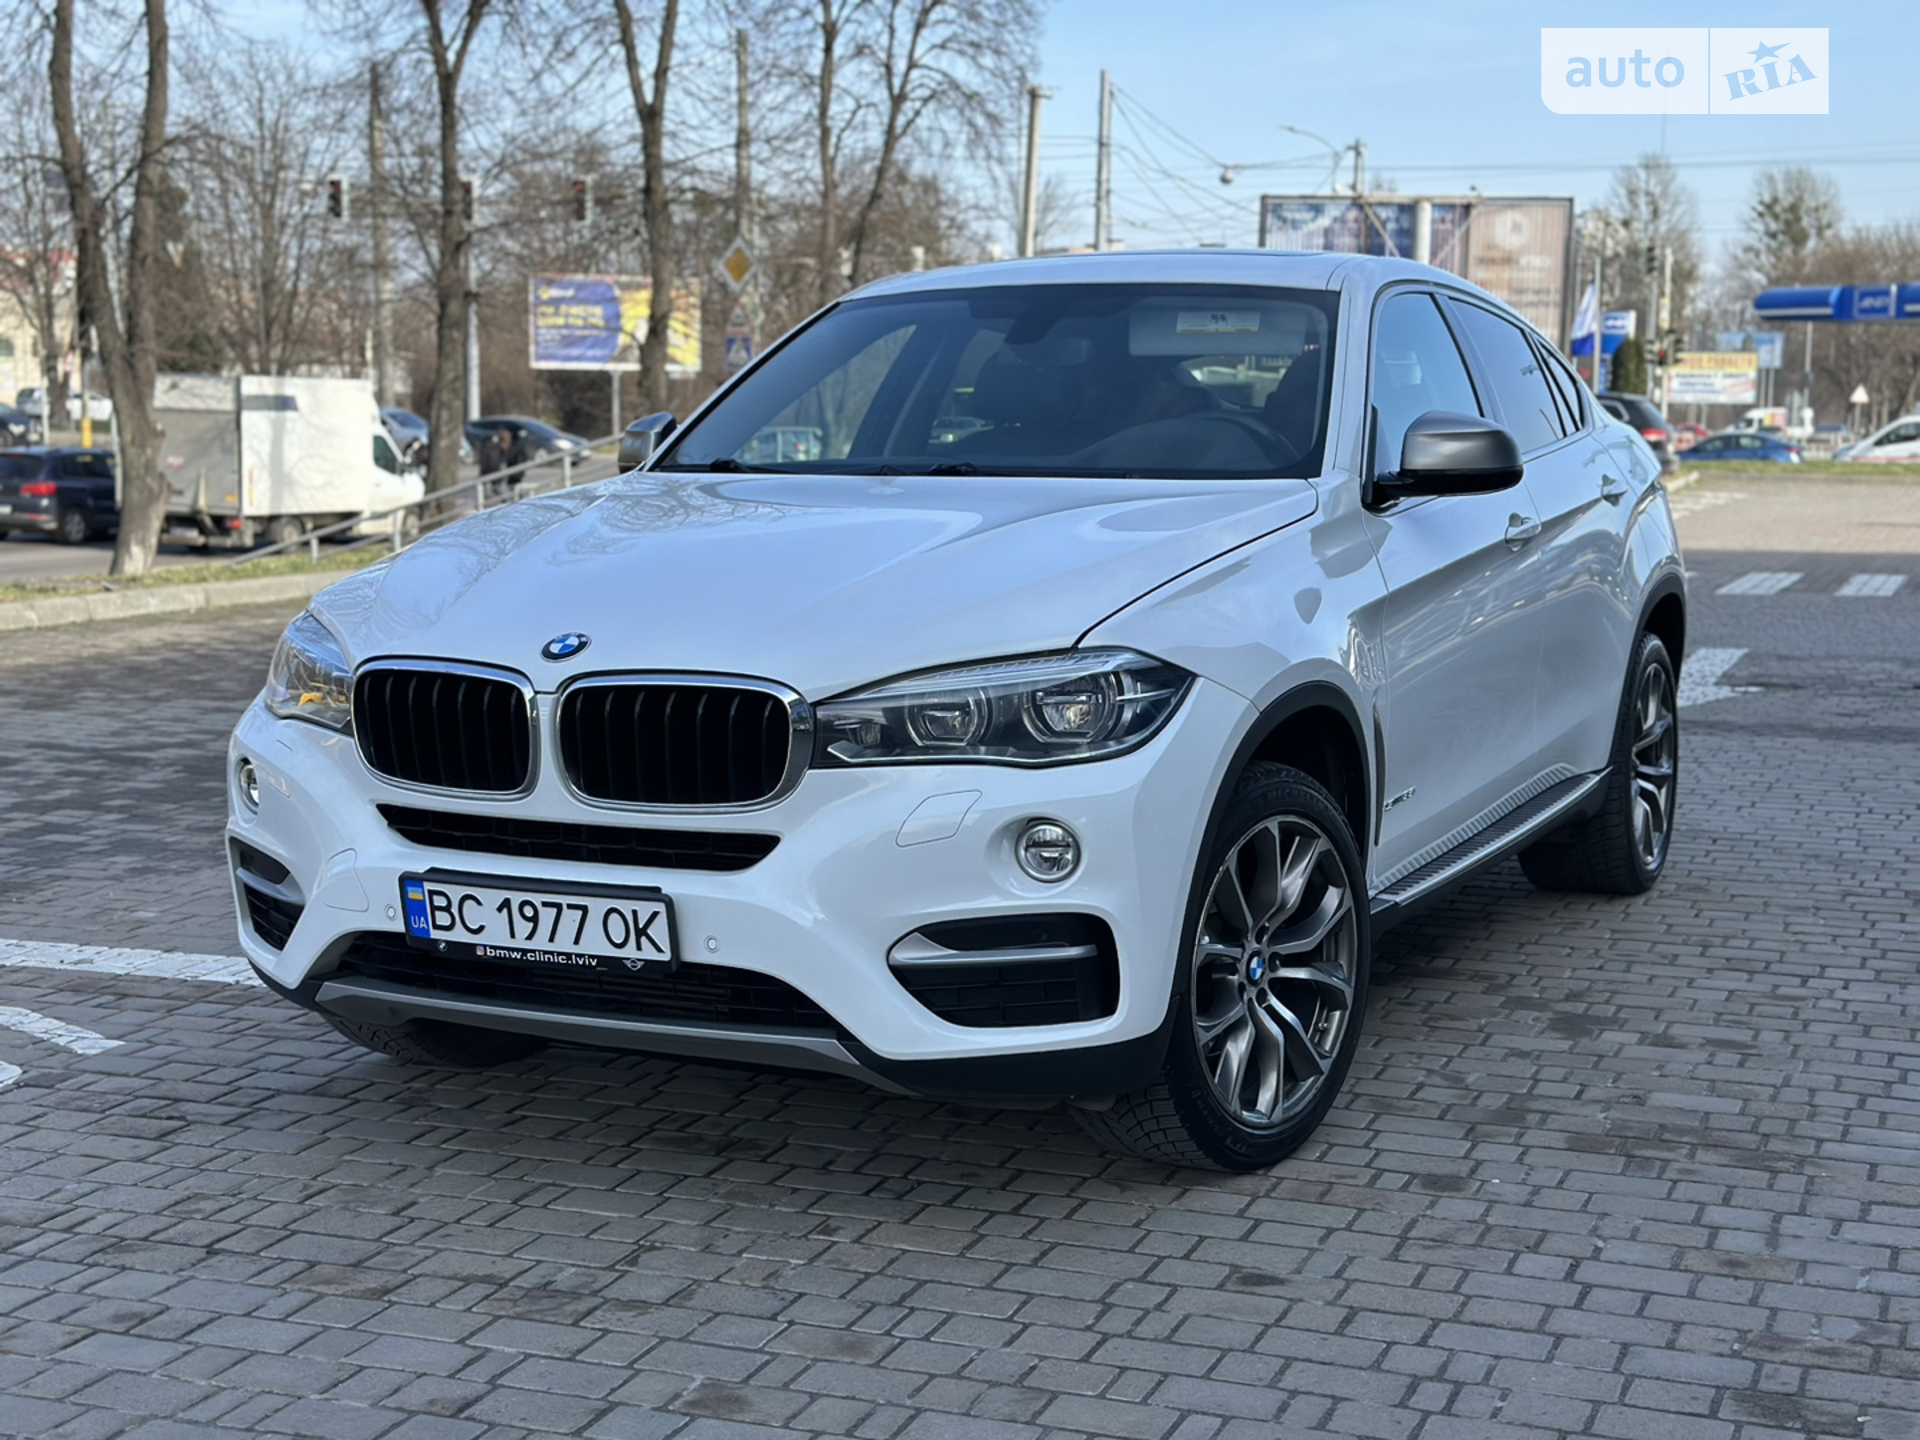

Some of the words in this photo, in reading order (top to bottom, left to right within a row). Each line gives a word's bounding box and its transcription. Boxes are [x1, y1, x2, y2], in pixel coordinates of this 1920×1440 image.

[410, 915, 428, 930] UA
[427, 888, 486, 936] BC
[496, 896, 589, 946] 1977
[602, 906, 666, 954] OK
